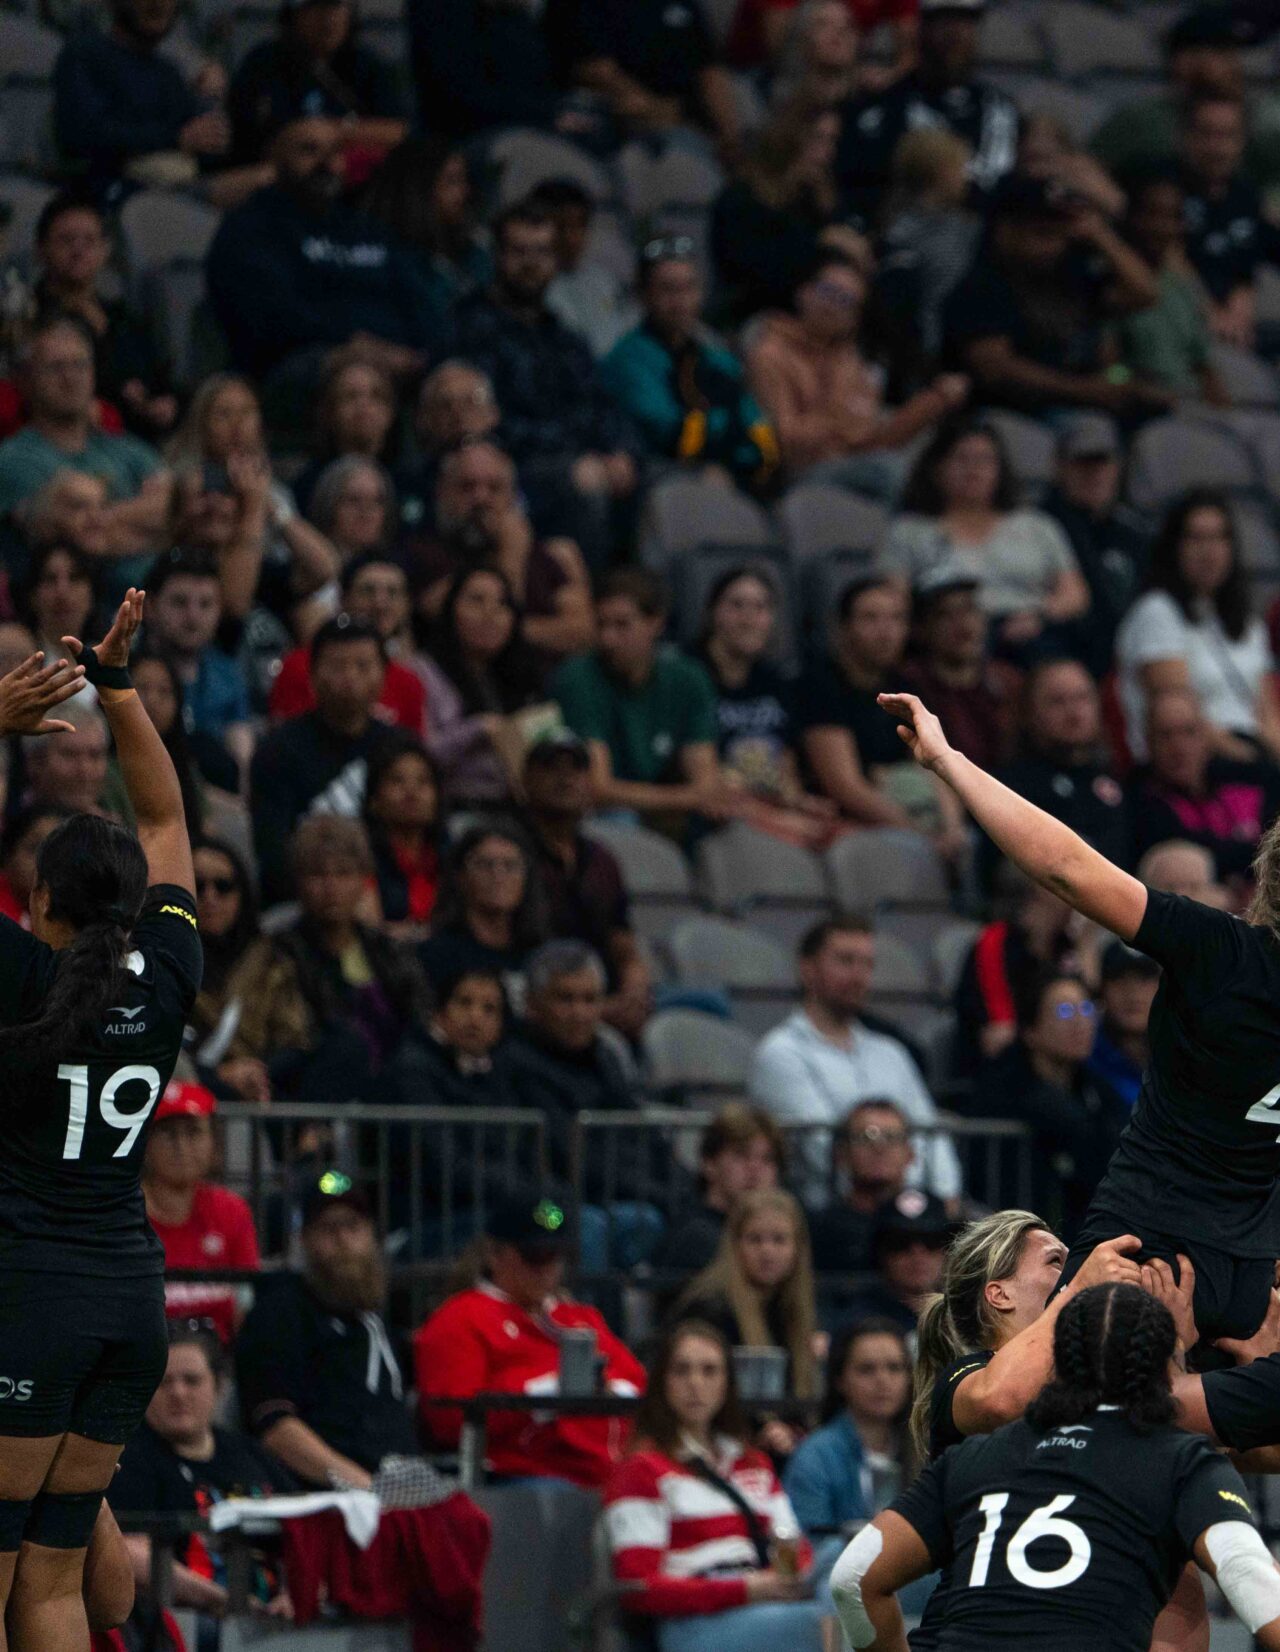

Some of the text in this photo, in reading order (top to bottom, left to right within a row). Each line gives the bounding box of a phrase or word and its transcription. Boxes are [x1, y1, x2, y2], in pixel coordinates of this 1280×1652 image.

[104, 1022, 146, 1035] ALTRAD
[57, 1064, 161, 1160] 19
[1036, 1437, 1088, 1450] ALTRAD
[968, 1492, 1092, 1589] 16
